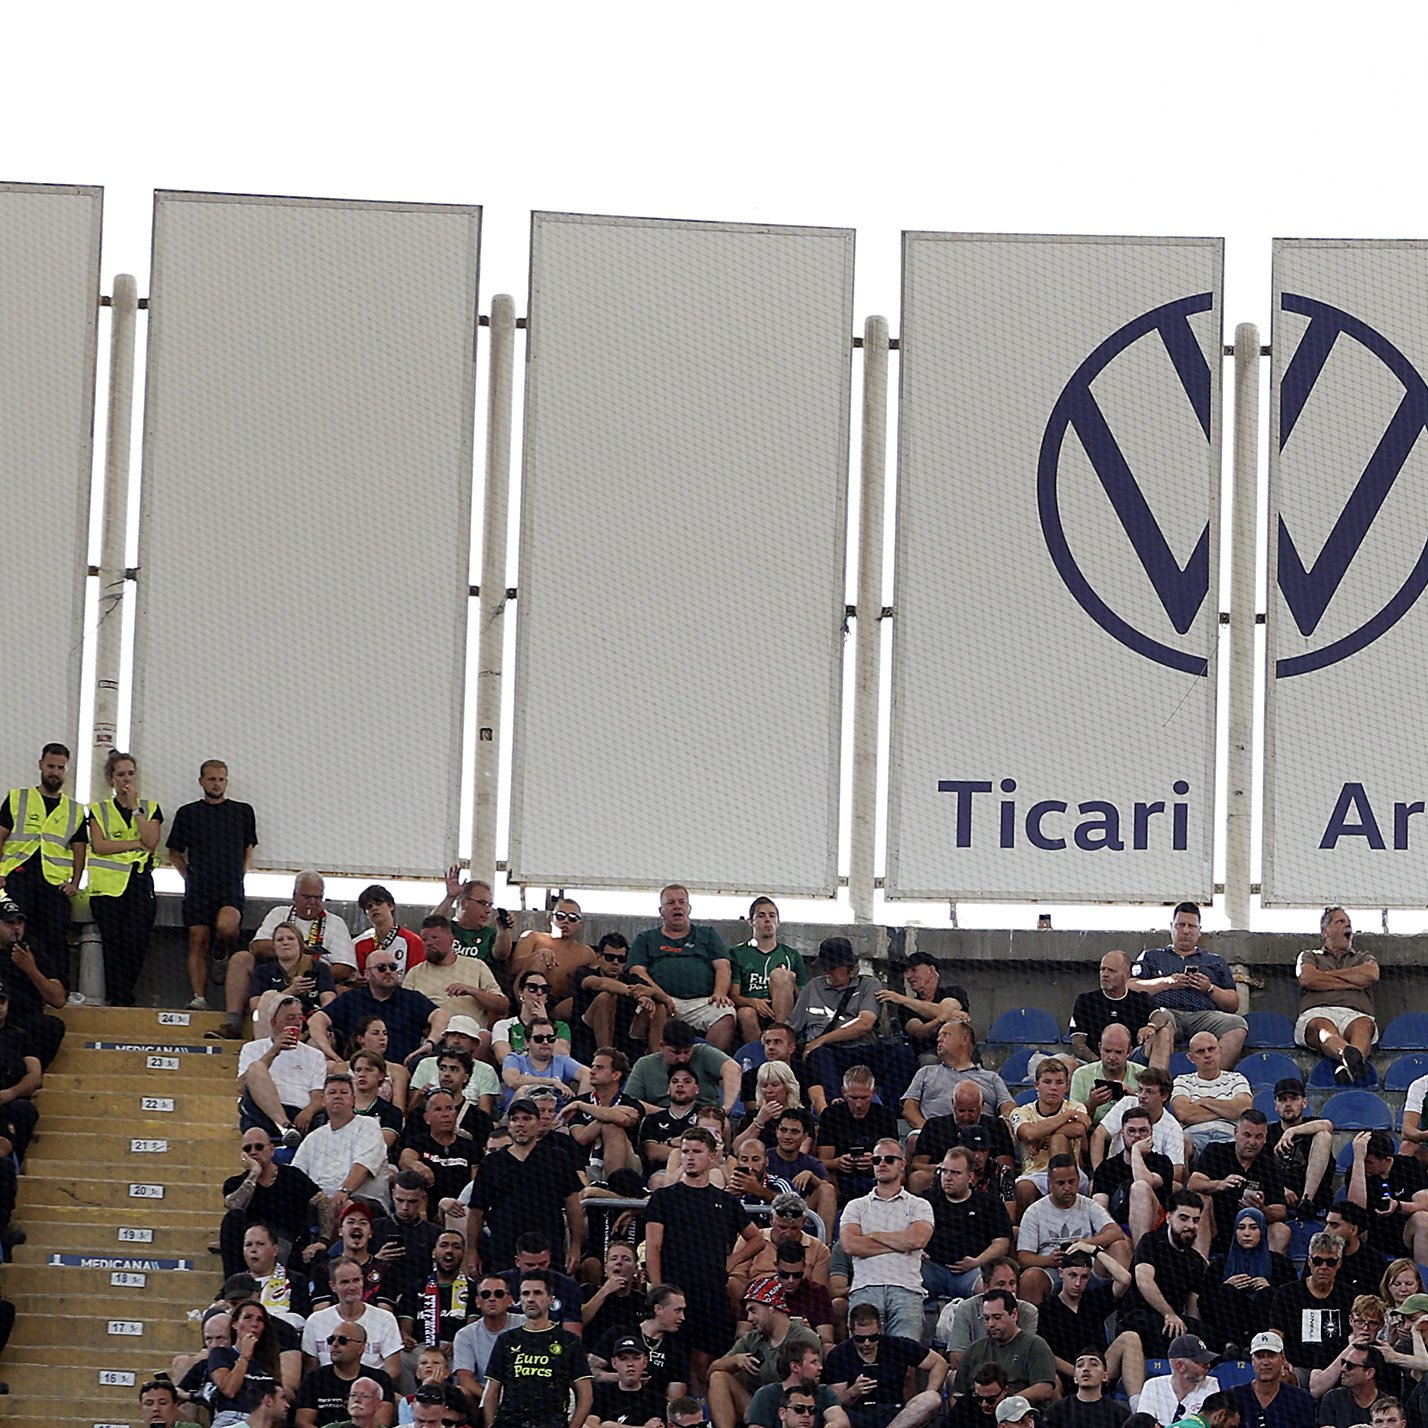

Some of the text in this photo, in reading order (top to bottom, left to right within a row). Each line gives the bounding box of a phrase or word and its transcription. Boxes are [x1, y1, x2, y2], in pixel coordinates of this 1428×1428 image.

[938, 778, 1189, 851] Ticari
[162, 1014, 174, 1023] 24
[151, 1058, 163, 1067] 23
[146, 1100, 158, 1109] 22
[135, 1141, 147, 1150] 21
[134, 1186, 146, 1195] 20
[123, 1230, 135, 1239] 19
[80, 1258, 151, 1270] MEDICANA
[116, 1274, 128, 1283] 18
[113, 1324, 125, 1333] 17
[514, 1352, 549, 1365] Euro
[514, 1365, 552, 1378] Parcs
[105, 1373, 117, 1383] 16
